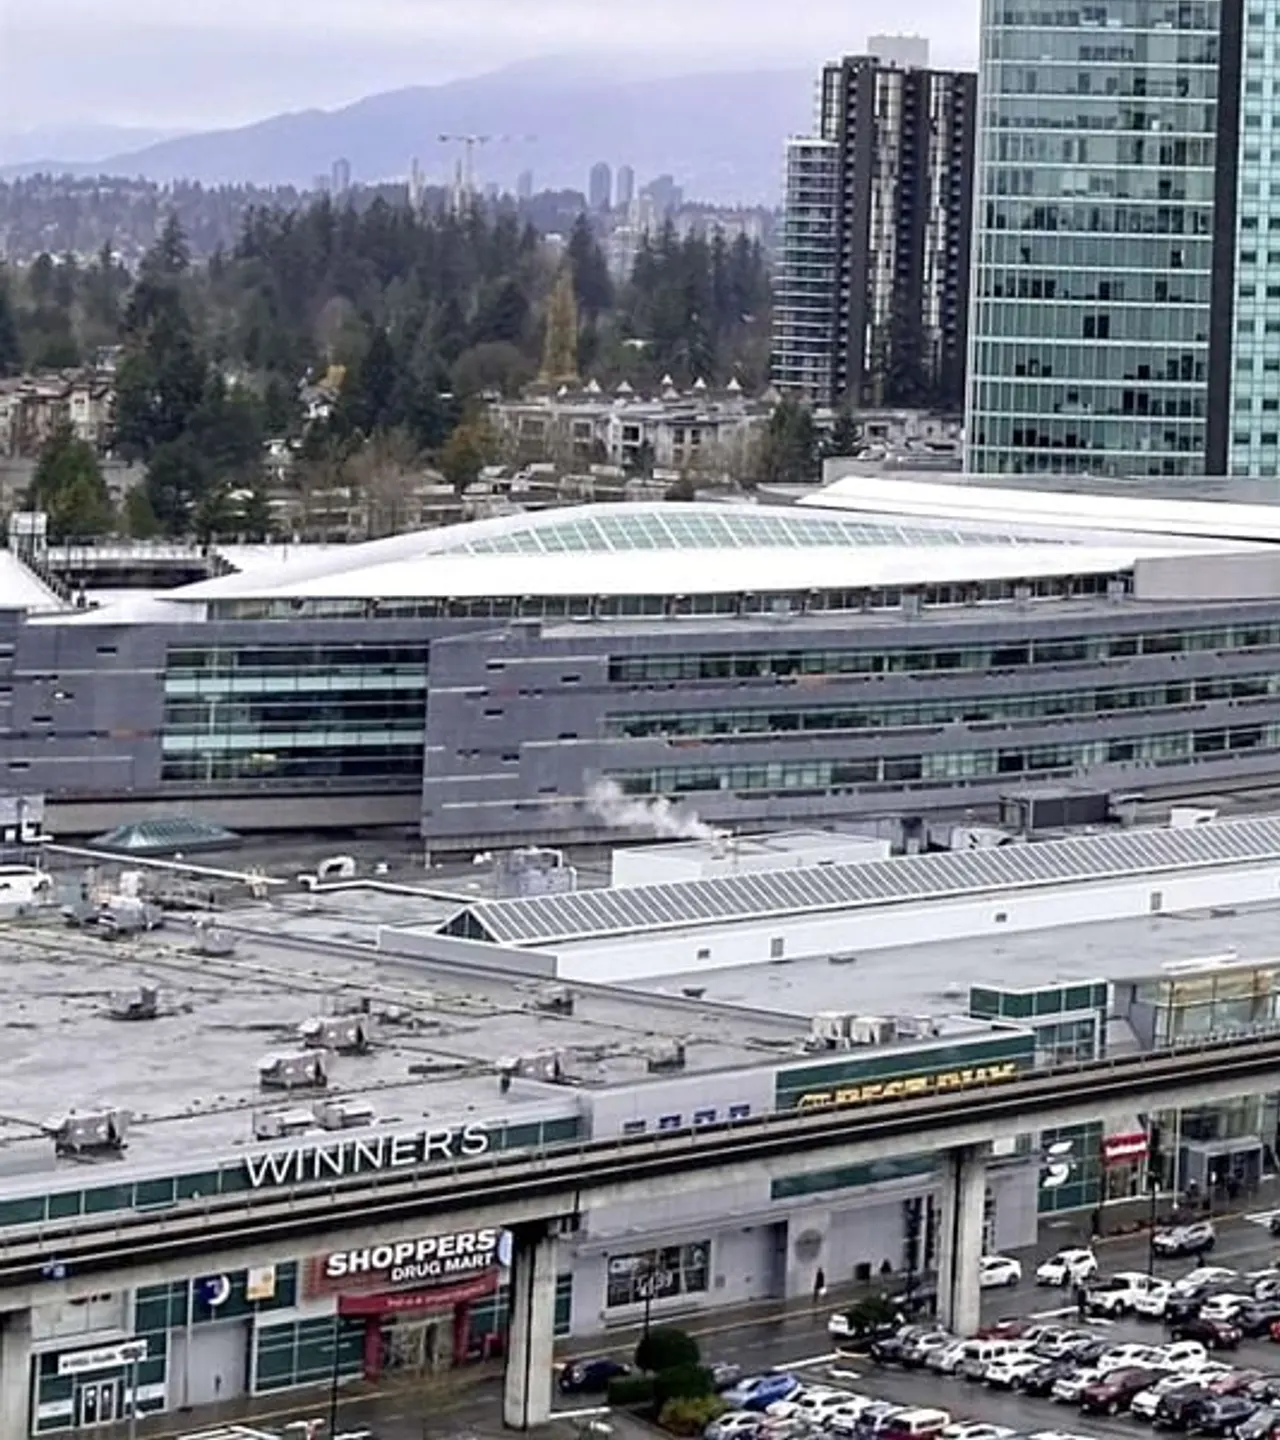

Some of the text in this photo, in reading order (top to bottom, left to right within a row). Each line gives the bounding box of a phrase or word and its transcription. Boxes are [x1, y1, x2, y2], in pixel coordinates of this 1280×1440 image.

[245, 1121, 489, 1188] WINNERS
[326, 1228, 496, 1277] SHOPPERS
[391, 1252, 493, 1281] DRUG MART
